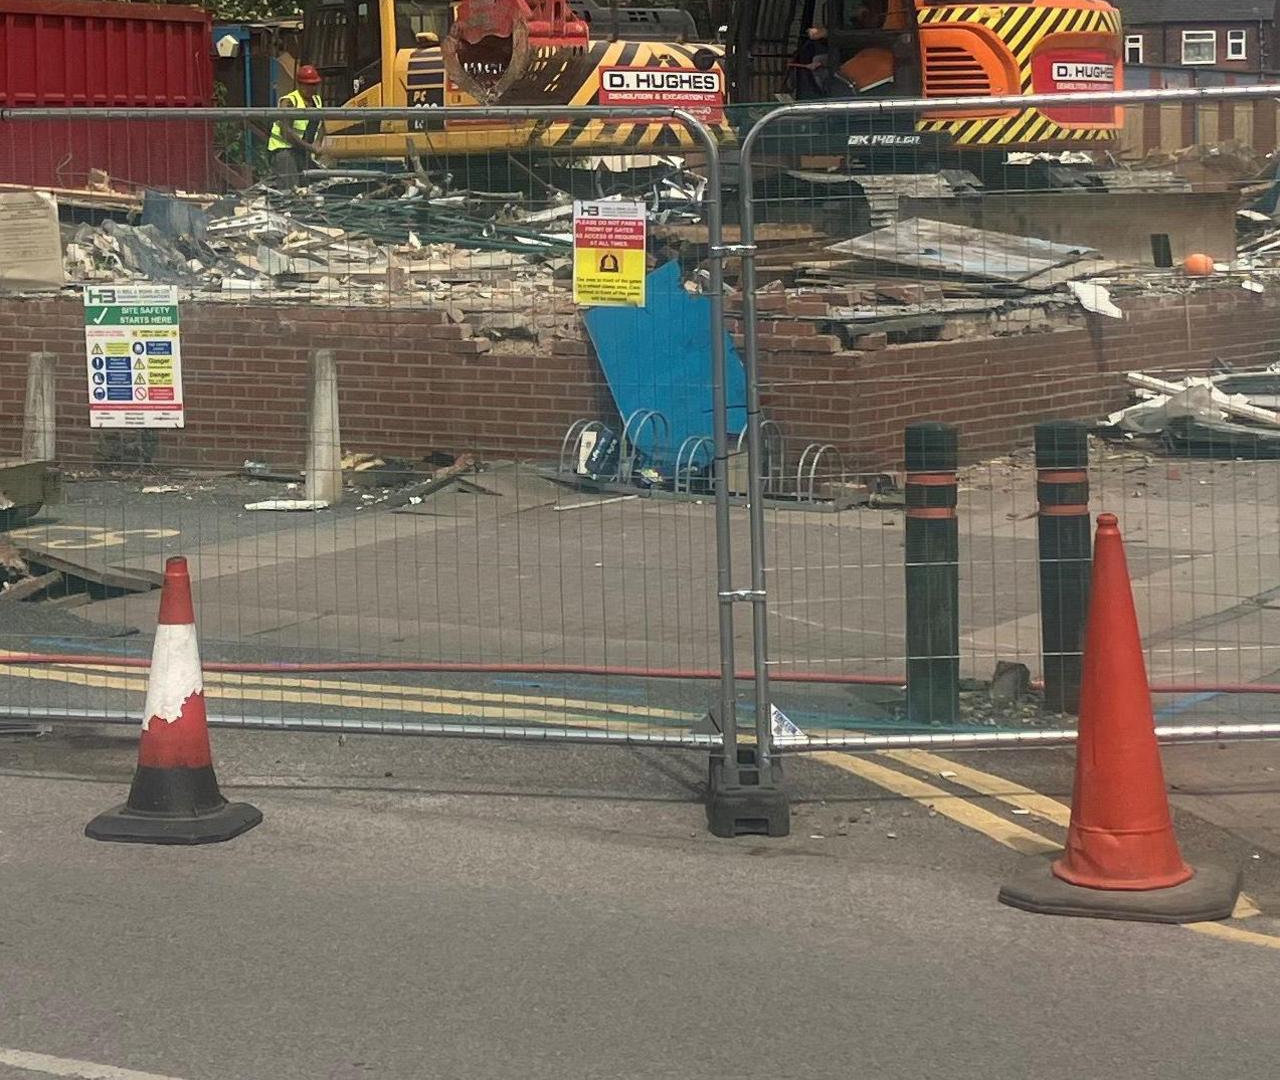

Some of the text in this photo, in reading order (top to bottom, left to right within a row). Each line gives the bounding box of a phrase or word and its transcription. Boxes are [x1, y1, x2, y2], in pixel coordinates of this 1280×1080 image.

[1057, 65, 1073, 77] D.
[609, 73, 715, 90] D. HUGHES
[121, 306, 170, 315] SITE SAFETY
[120, 316, 173, 324] STARTS HERE
[149, 371, 171, 379] Danger
